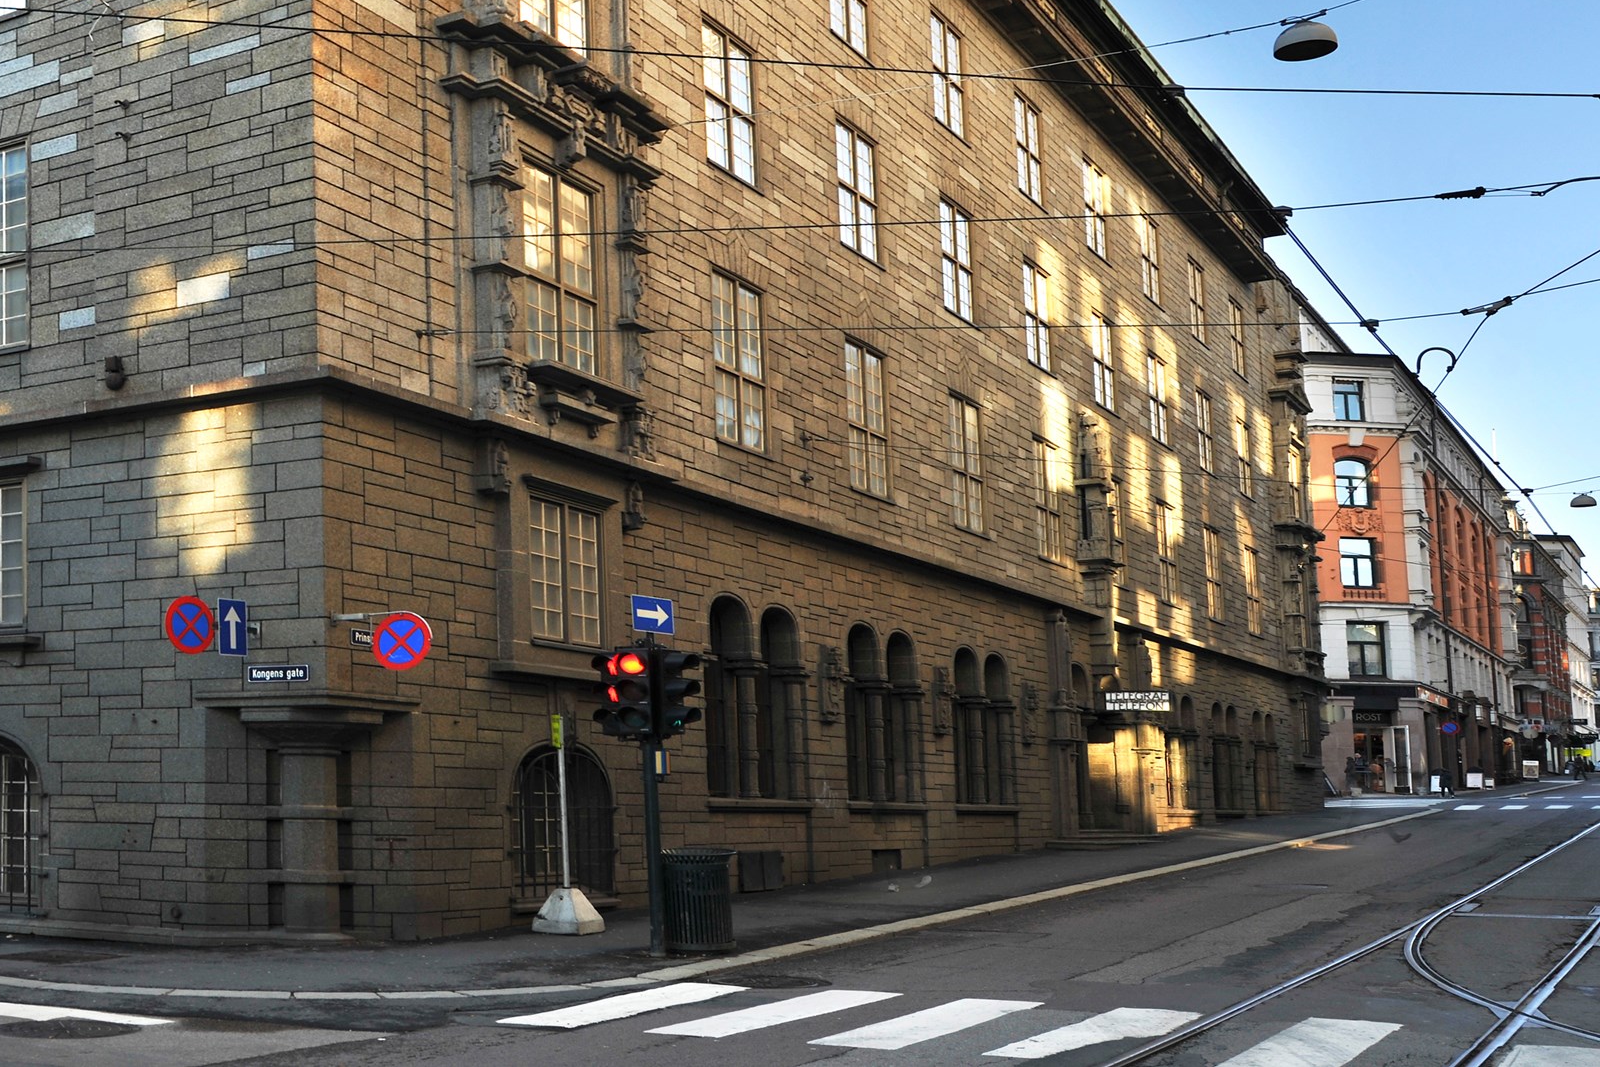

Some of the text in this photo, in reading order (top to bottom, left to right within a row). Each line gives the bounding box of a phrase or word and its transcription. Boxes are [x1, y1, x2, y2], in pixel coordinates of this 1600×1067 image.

[355, 631, 371, 643] Prins
[252, 668, 304, 681] Kongens gate
[1106, 691, 1168, 701] TELEGRAF
[1109, 701, 1164, 711] TELEFON
